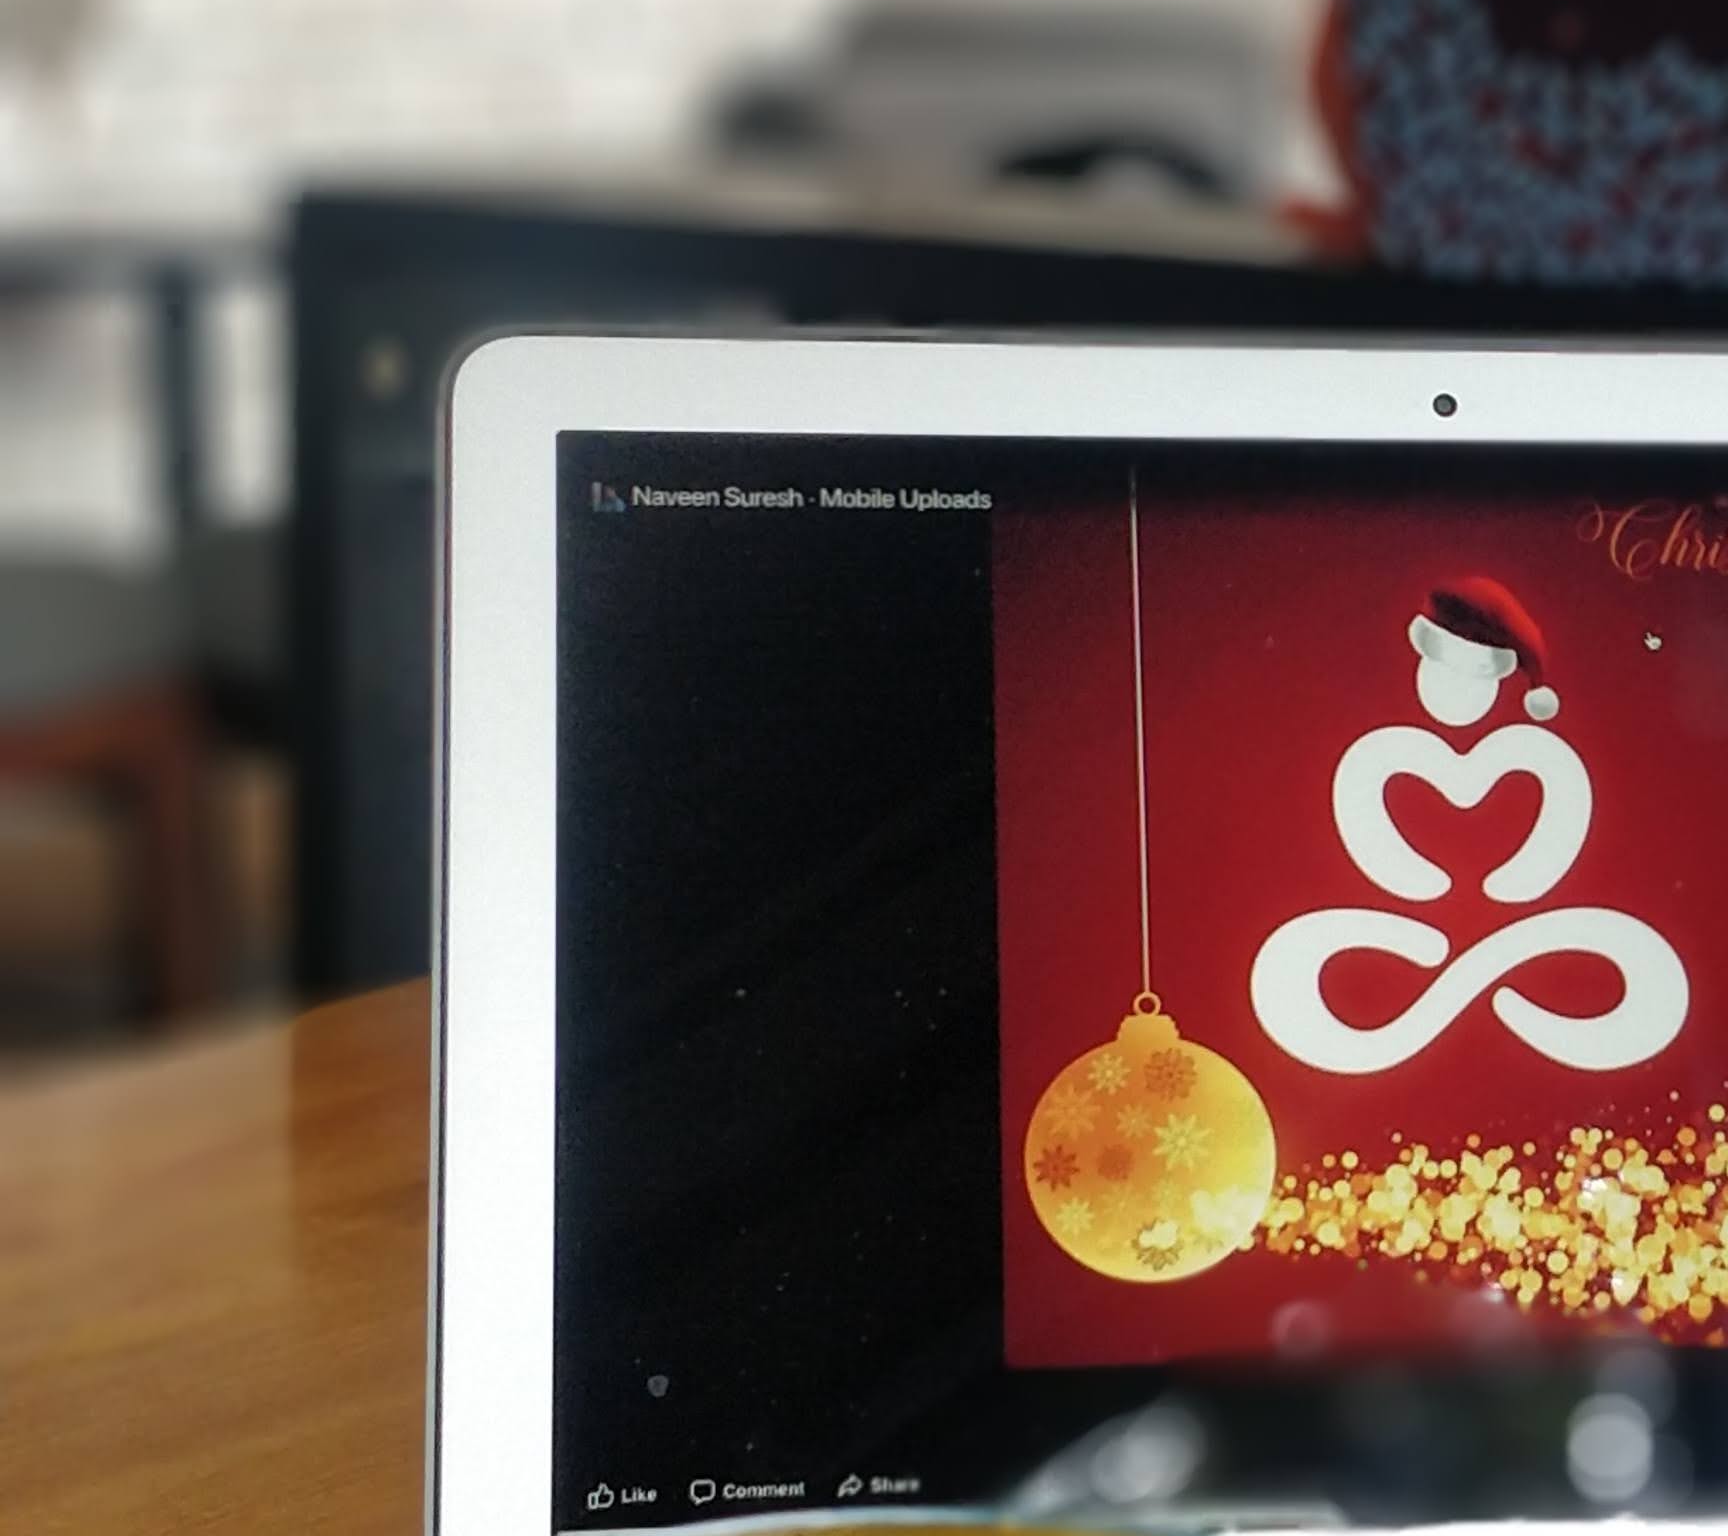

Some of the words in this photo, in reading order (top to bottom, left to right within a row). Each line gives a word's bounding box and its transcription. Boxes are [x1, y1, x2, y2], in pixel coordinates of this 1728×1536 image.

[631, 484, 720, 507] Naveen
[724, 485, 804, 509] Suresh
[820, 487, 895, 510] Mobile
[900, 488, 992, 513] Uploads
[621, 1485, 658, 1505] Like
[722, 1480, 806, 1501] Comment
[869, 1475, 920, 1494] Share
